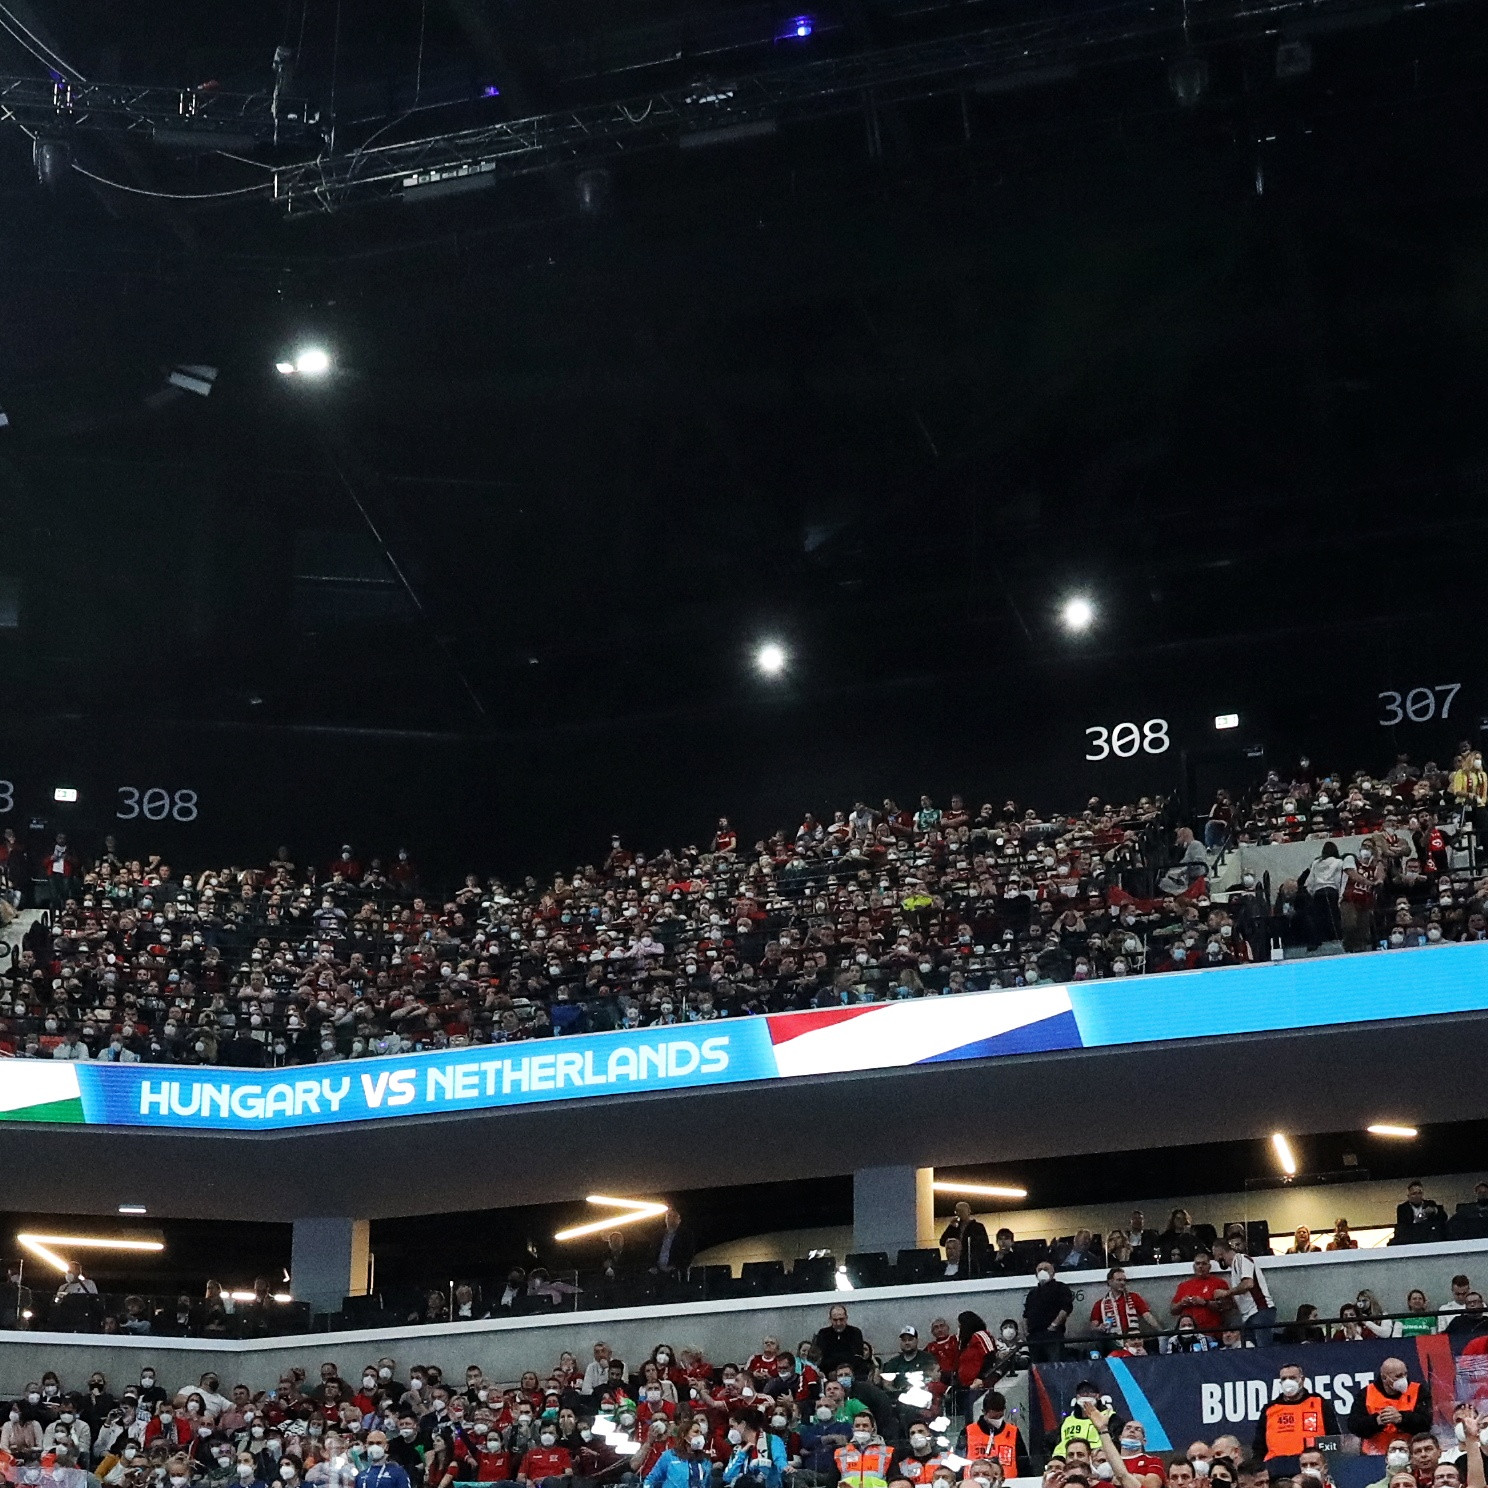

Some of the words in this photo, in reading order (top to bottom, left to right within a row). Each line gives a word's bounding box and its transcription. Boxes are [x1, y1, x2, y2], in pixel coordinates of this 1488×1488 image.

[1378, 683, 1462, 726] 307
[1086, 718, 1170, 761] 308
[116, 786, 198, 822] 308
[141, 1075, 350, 1118] HUNGARY
[360, 1068, 416, 1108] VS
[425, 1036, 730, 1102] NETHERLANDS
[1201, 1372, 1375, 1424] BUDEST
[1318, 1442, 1338, 1451] Exit
